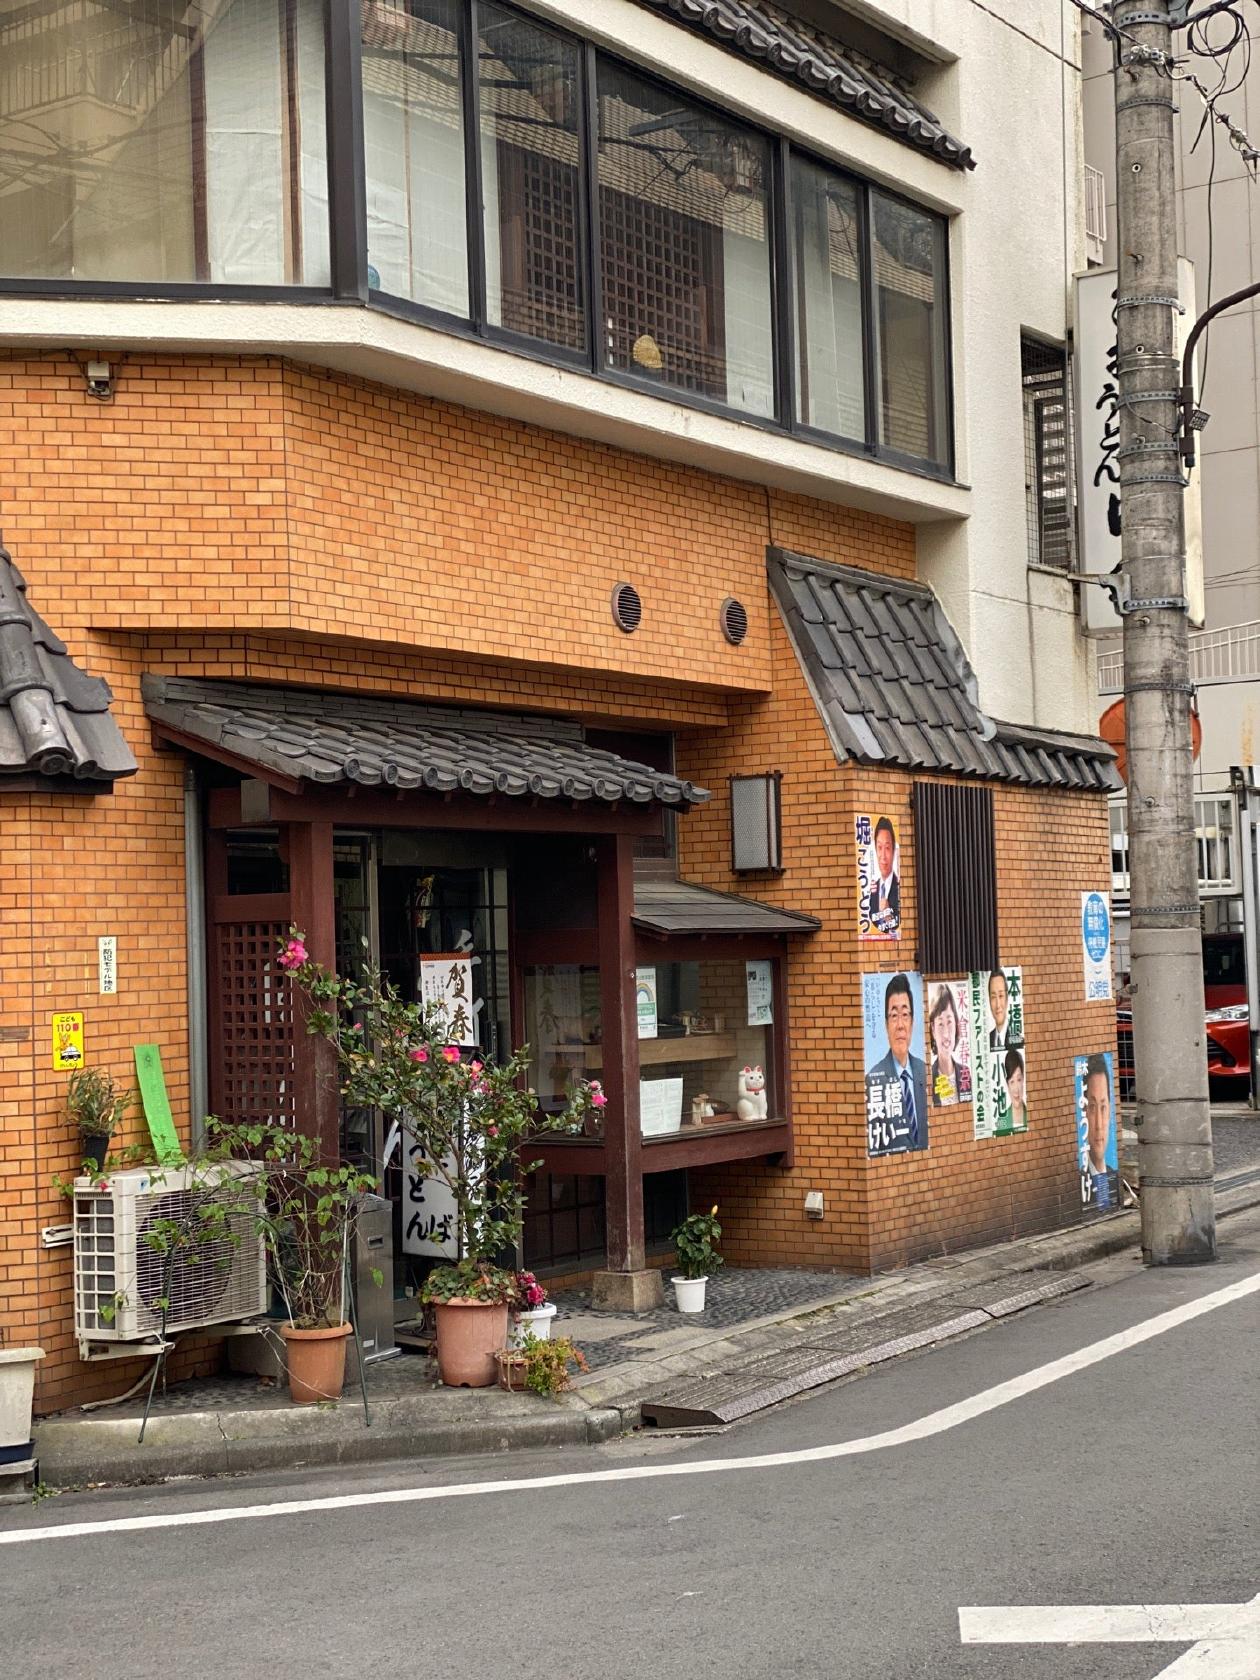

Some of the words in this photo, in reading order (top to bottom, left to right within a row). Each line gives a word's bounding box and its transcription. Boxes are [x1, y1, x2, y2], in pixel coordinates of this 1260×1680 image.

[1007, 969, 1022, 1037] 本橋
[971, 971, 985, 1122] 都民ファーストの会
[867, 1082, 903, 1121] 長橋
[992, 1054, 1008, 1119] 小池
[1079, 1080, 1092, 1202] ようすけ
